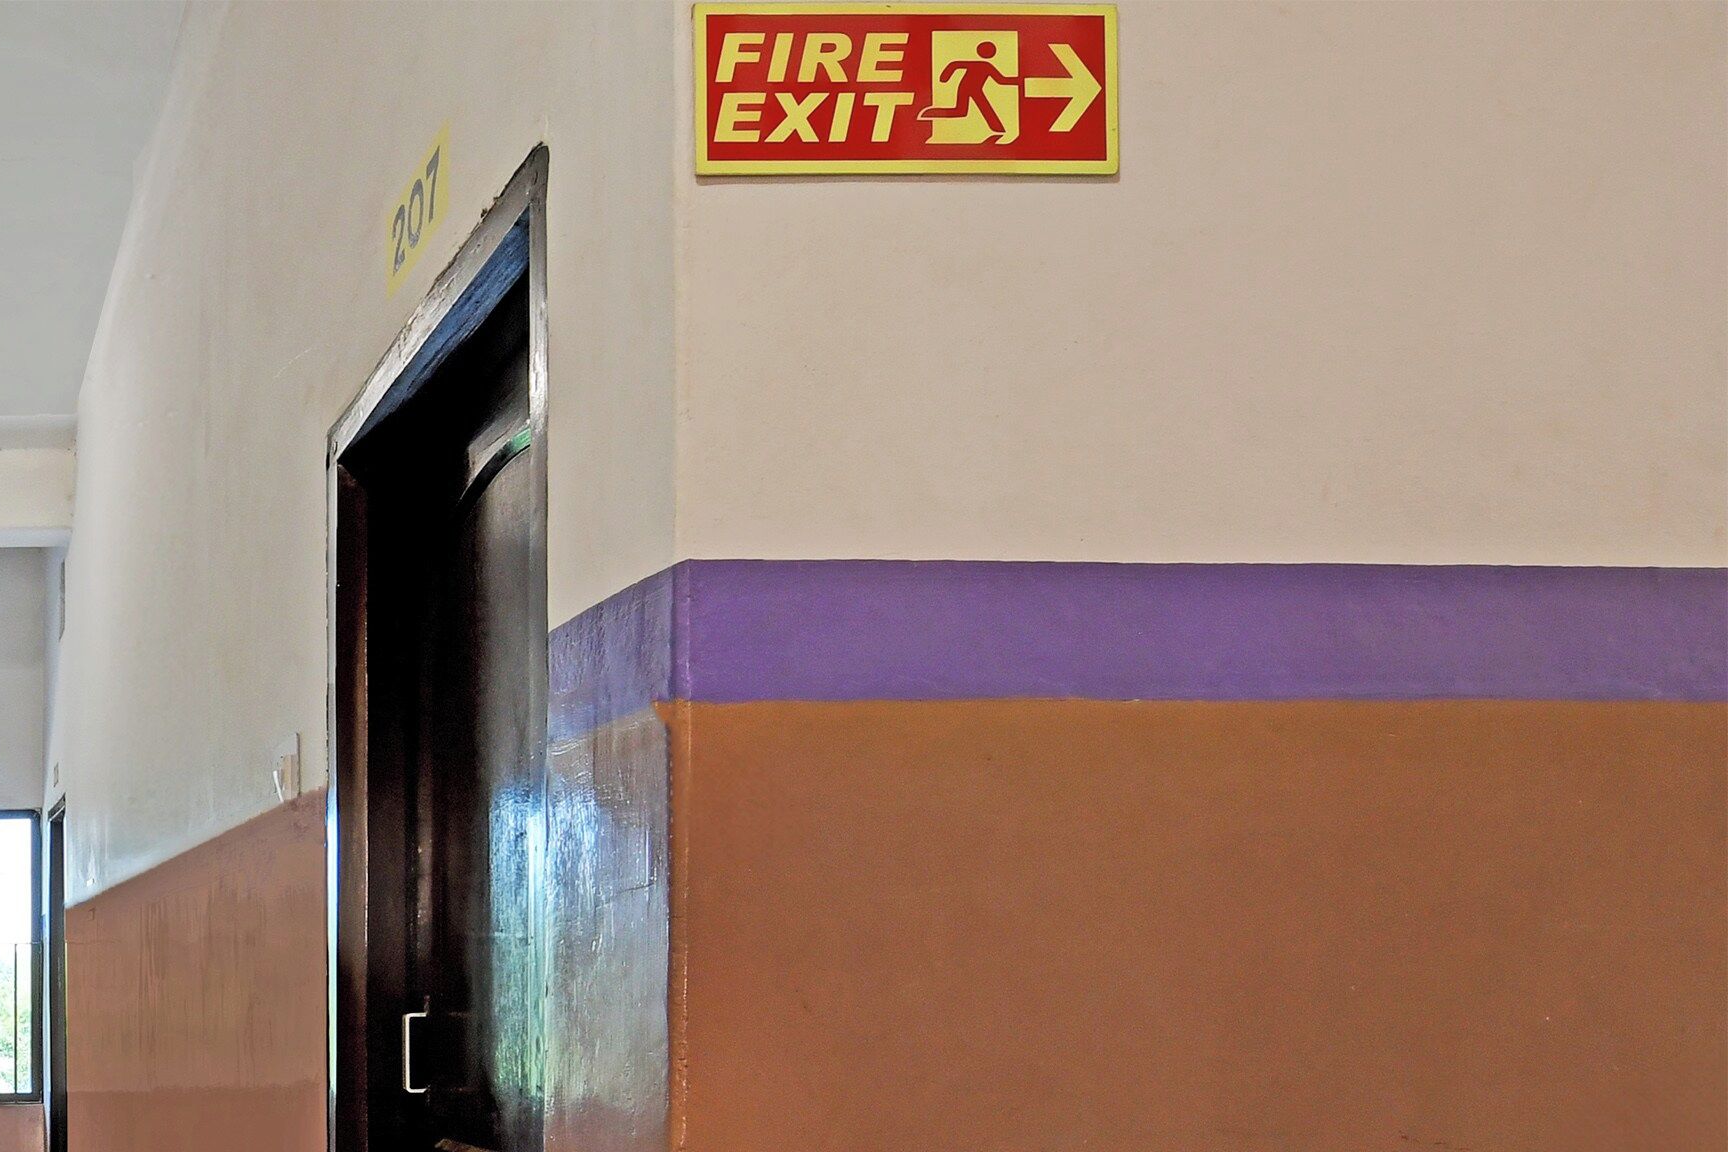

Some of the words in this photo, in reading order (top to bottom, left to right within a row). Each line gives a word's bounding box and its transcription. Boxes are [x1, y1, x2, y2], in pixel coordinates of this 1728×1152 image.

[714, 32, 910, 83] FIRE
[713, 92, 915, 143] EXIT
[392, 144, 441, 277] 207
